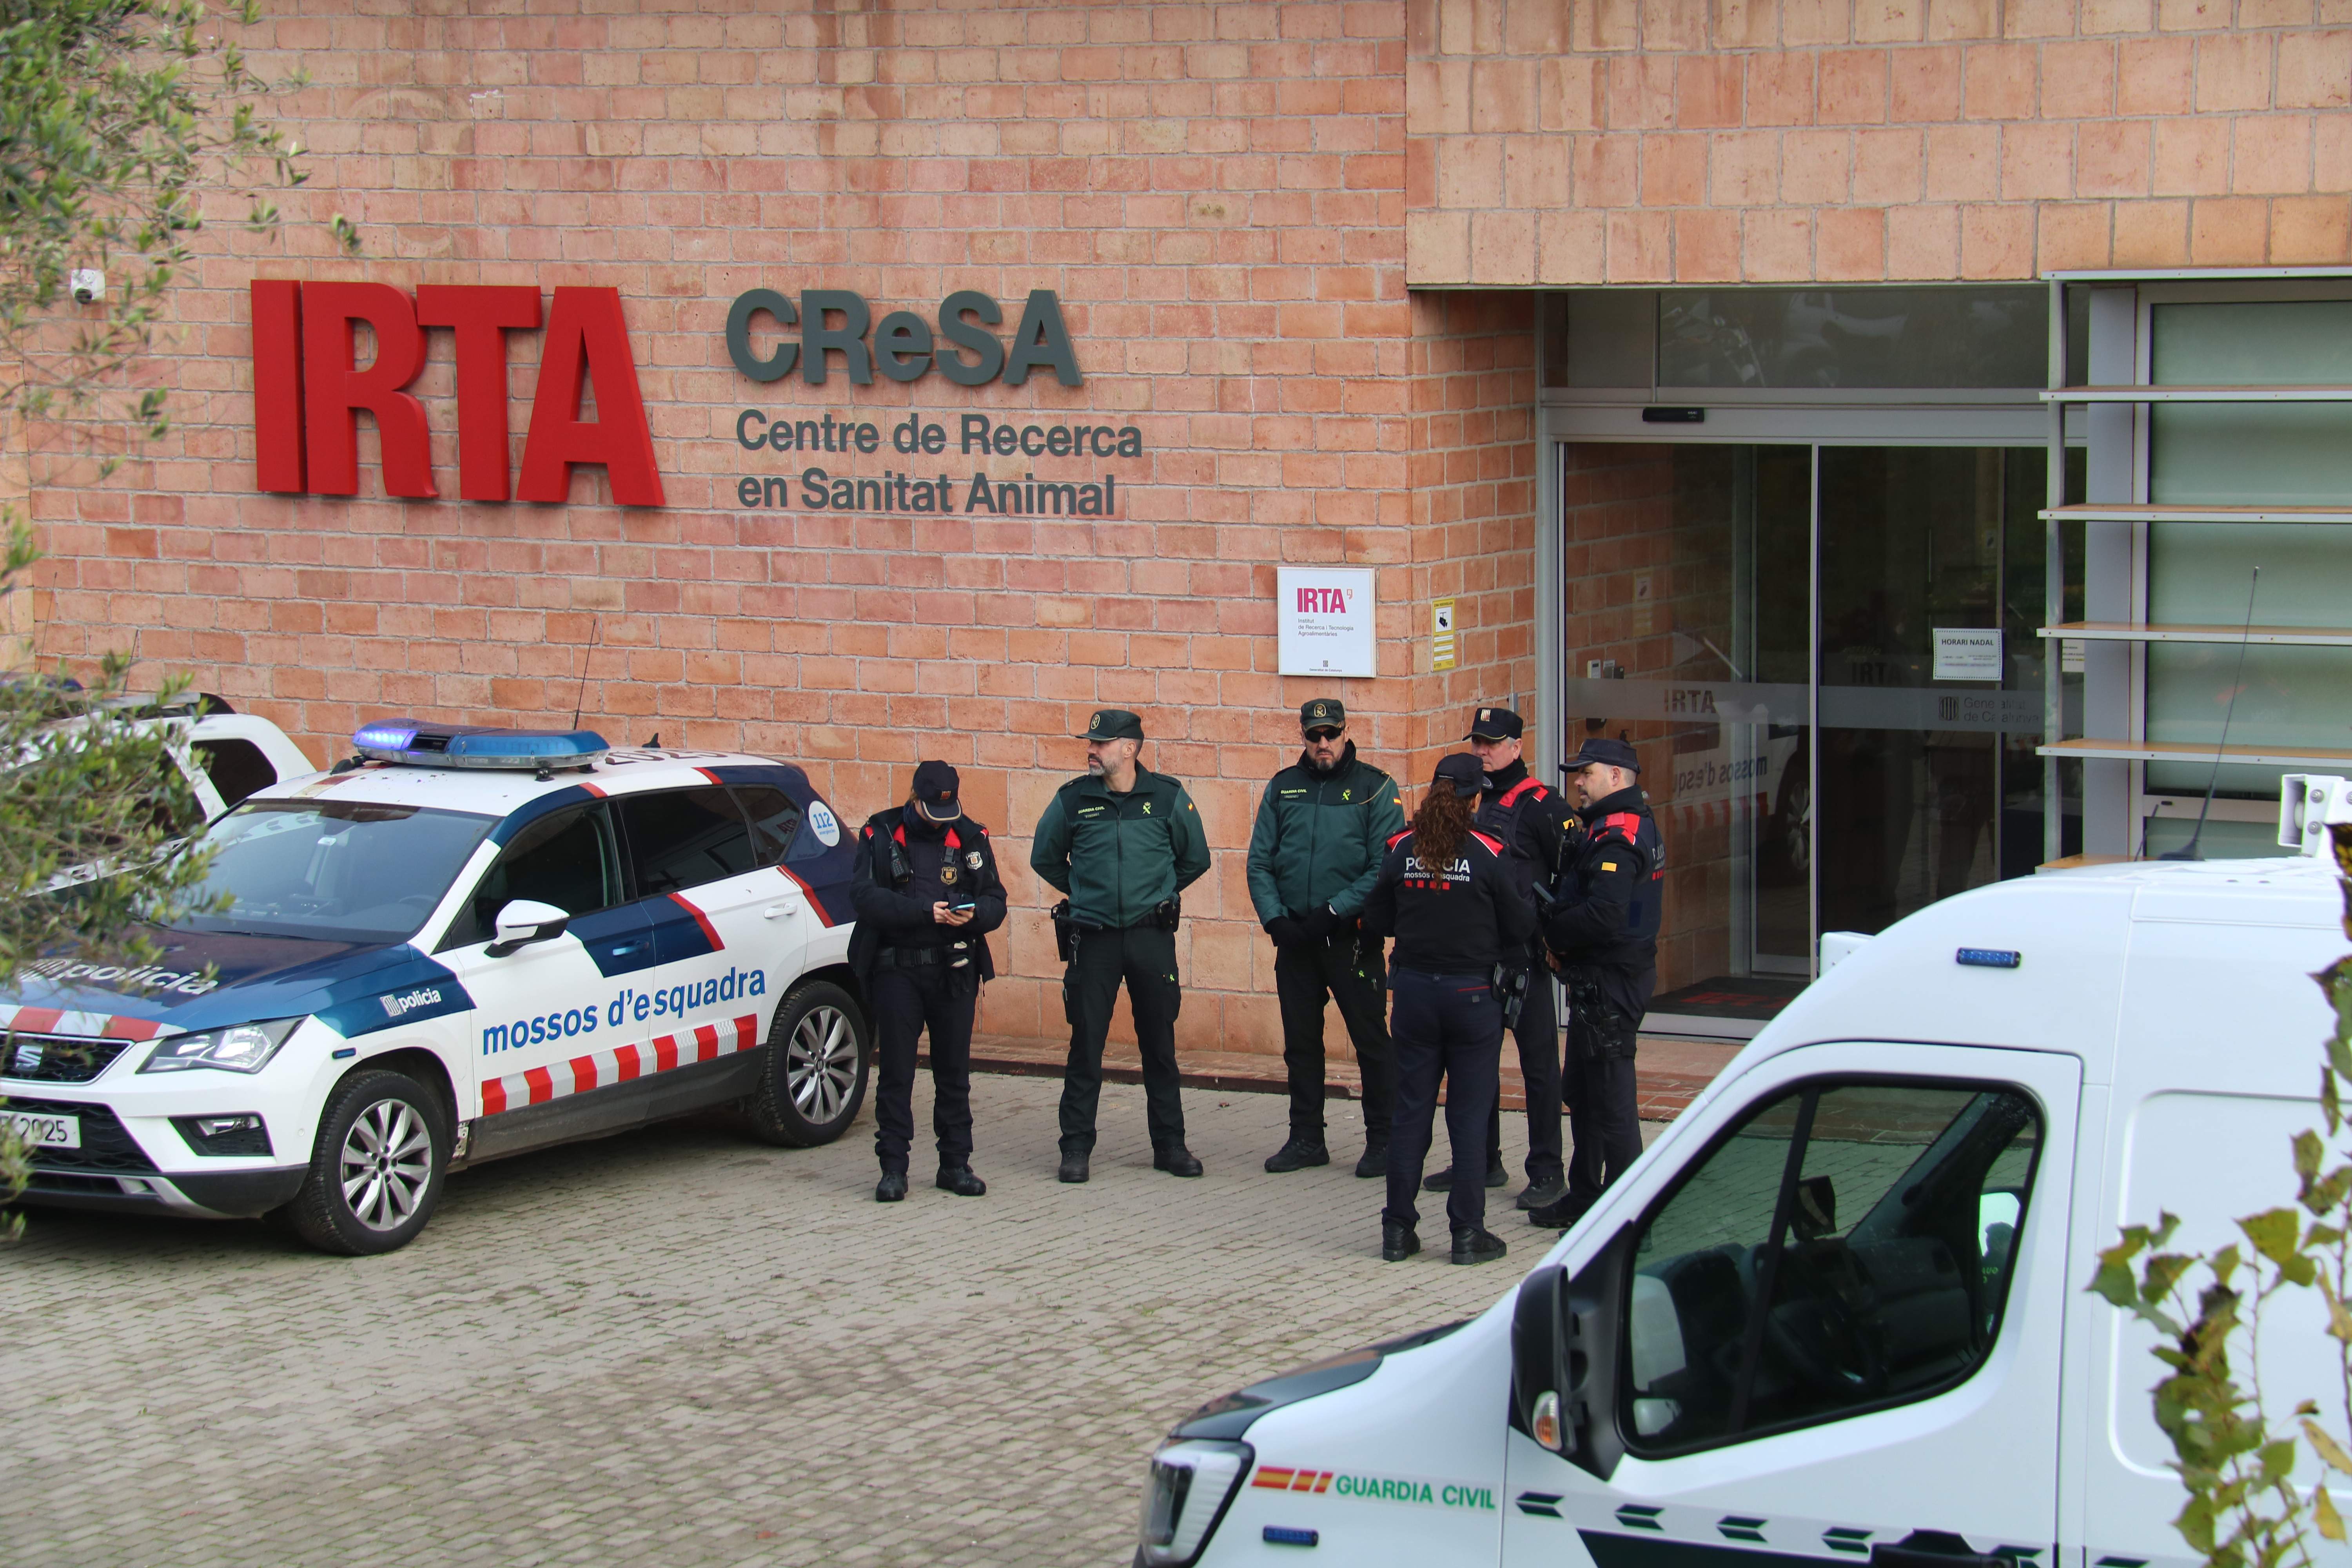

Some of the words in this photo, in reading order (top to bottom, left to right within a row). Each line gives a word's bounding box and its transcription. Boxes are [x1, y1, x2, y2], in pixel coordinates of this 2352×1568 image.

[726, 288, 1083, 386] CReSA
[250, 279, 665, 506] IRTA
[737, 409, 879, 454] Centre
[893, 413, 946, 454] de
[961, 414, 1142, 457] Recerca
[738, 475, 787, 507] en
[801, 467, 953, 512] Sanitat
[965, 473, 1114, 515] Animal
[1297, 588, 1346, 613] IRTA
[1664, 689, 1716, 713] IRTA
[1964, 697, 2026, 710] Genealitat
[1964, 710, 1978, 722] de
[813, 812, 833, 829] 112
[1406, 857, 1470, 874] POCIA
[49, 964, 219, 995] policia
[398, 988, 442, 1013] policia
[483, 1005, 598, 1055] mossos
[608, 967, 766, 1027] d'esquadra
[1336, 1475, 1433, 1504] GUARDIA
[1442, 1485, 1495, 1509] CIVIL
